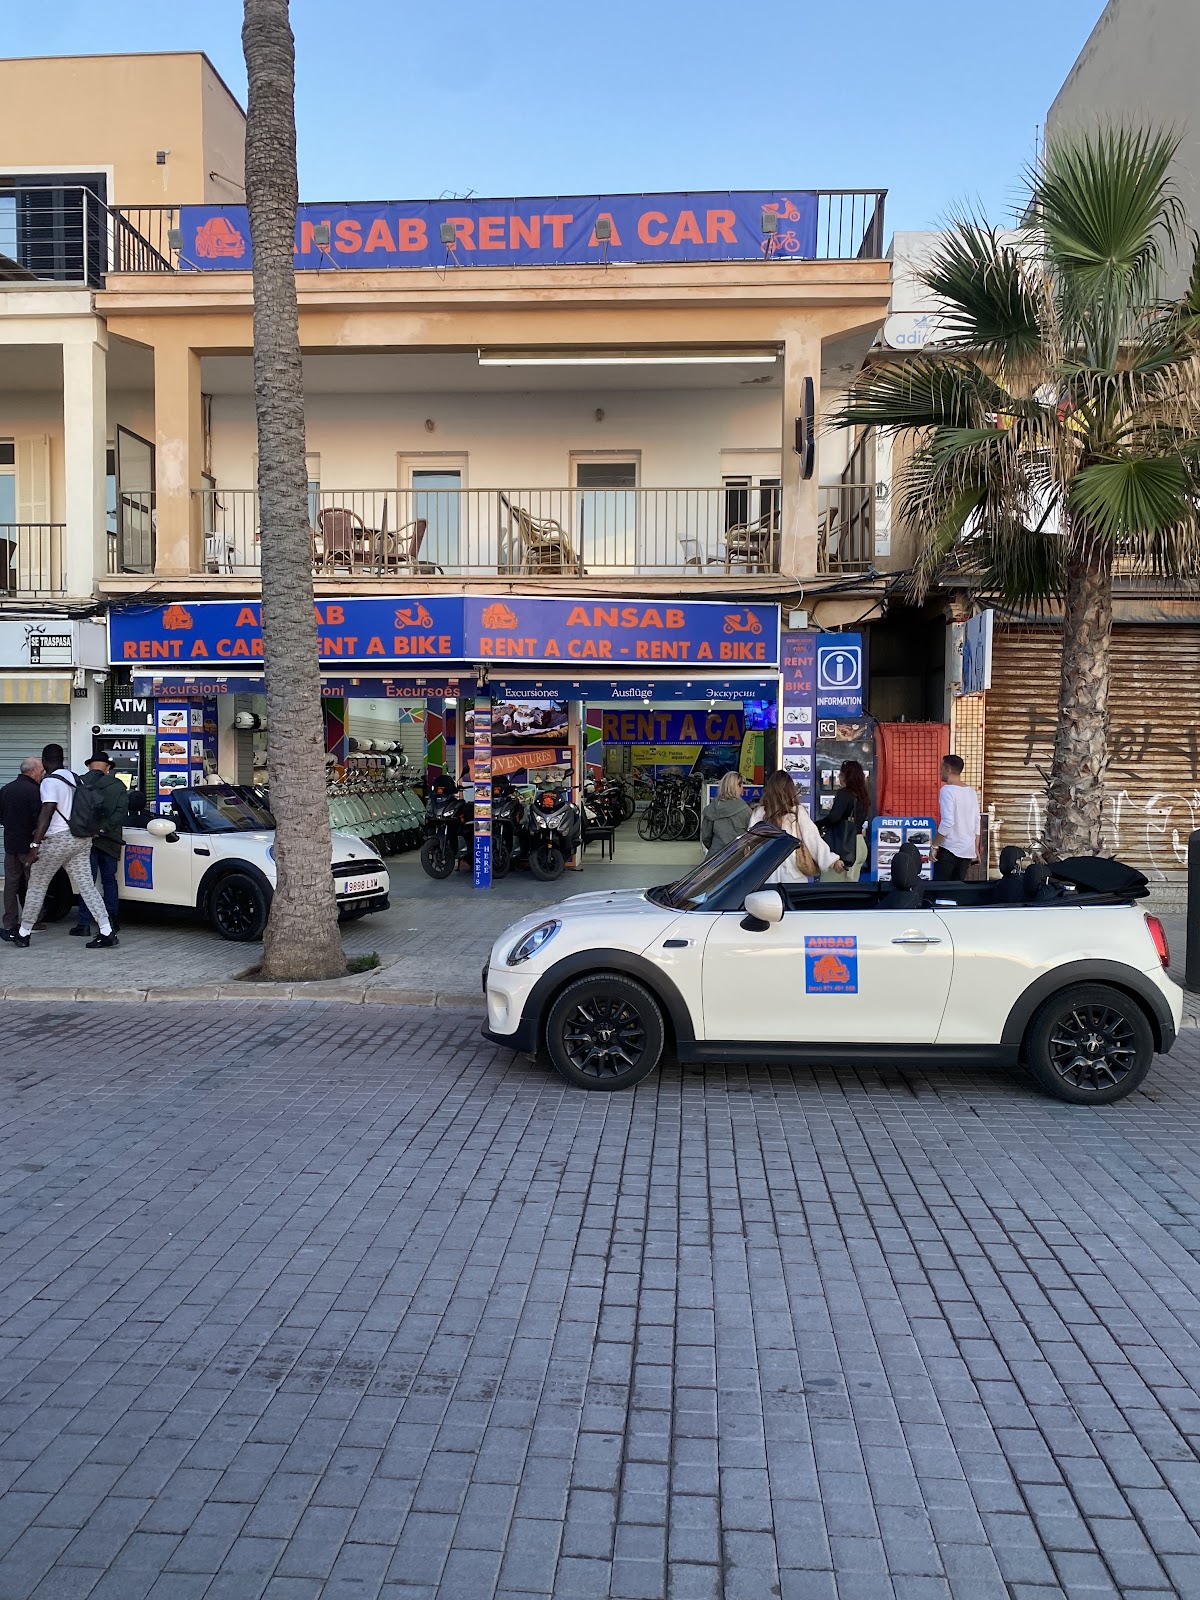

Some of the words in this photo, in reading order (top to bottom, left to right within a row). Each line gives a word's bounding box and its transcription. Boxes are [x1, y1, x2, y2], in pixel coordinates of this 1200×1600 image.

[293, 218, 427, 253] NSAB
[446, 214, 573, 250] RENT
[588, 212, 622, 246] A
[637, 209, 737, 245] CAR
[566, 607, 686, 628] ANSAB
[31, 636, 40, 647] SE
[40, 636, 71, 647] TRASPASA
[123, 640, 183, 658] RENT
[190, 640, 209, 657] A
[216, 638, 264, 657] CAR
[366, 637, 386, 655] A
[394, 635, 452, 654] BIKE
[480, 637, 538, 657] RENT
[544, 639, 560, 657] A
[567, 638, 613, 659] CAR
[636, 640, 691, 659] RENT
[697, 641, 713, 659] A
[719, 642, 766, 660] BIKE
[784, 657, 814, 666] RENT
[794, 669, 803, 678] A
[153, 683, 228, 695] Excursions
[785, 682, 812, 691] BIKE
[505, 688, 559, 698] Excursiones
[611, 687, 653, 699] Ausflüge
[705, 688, 756, 699] Экскурсии
[113, 699, 147, 712] ATM
[817, 697, 862, 706] INFORMATION
[603, 713, 673, 741] RENT
[679, 713, 698, 741] A
[705, 713, 745, 741] CA
[820, 723, 834, 733] RC
[112, 740, 139, 750] ATM
[911, 819, 929, 827] CAR
[808, 937, 855, 948] ANSAB
